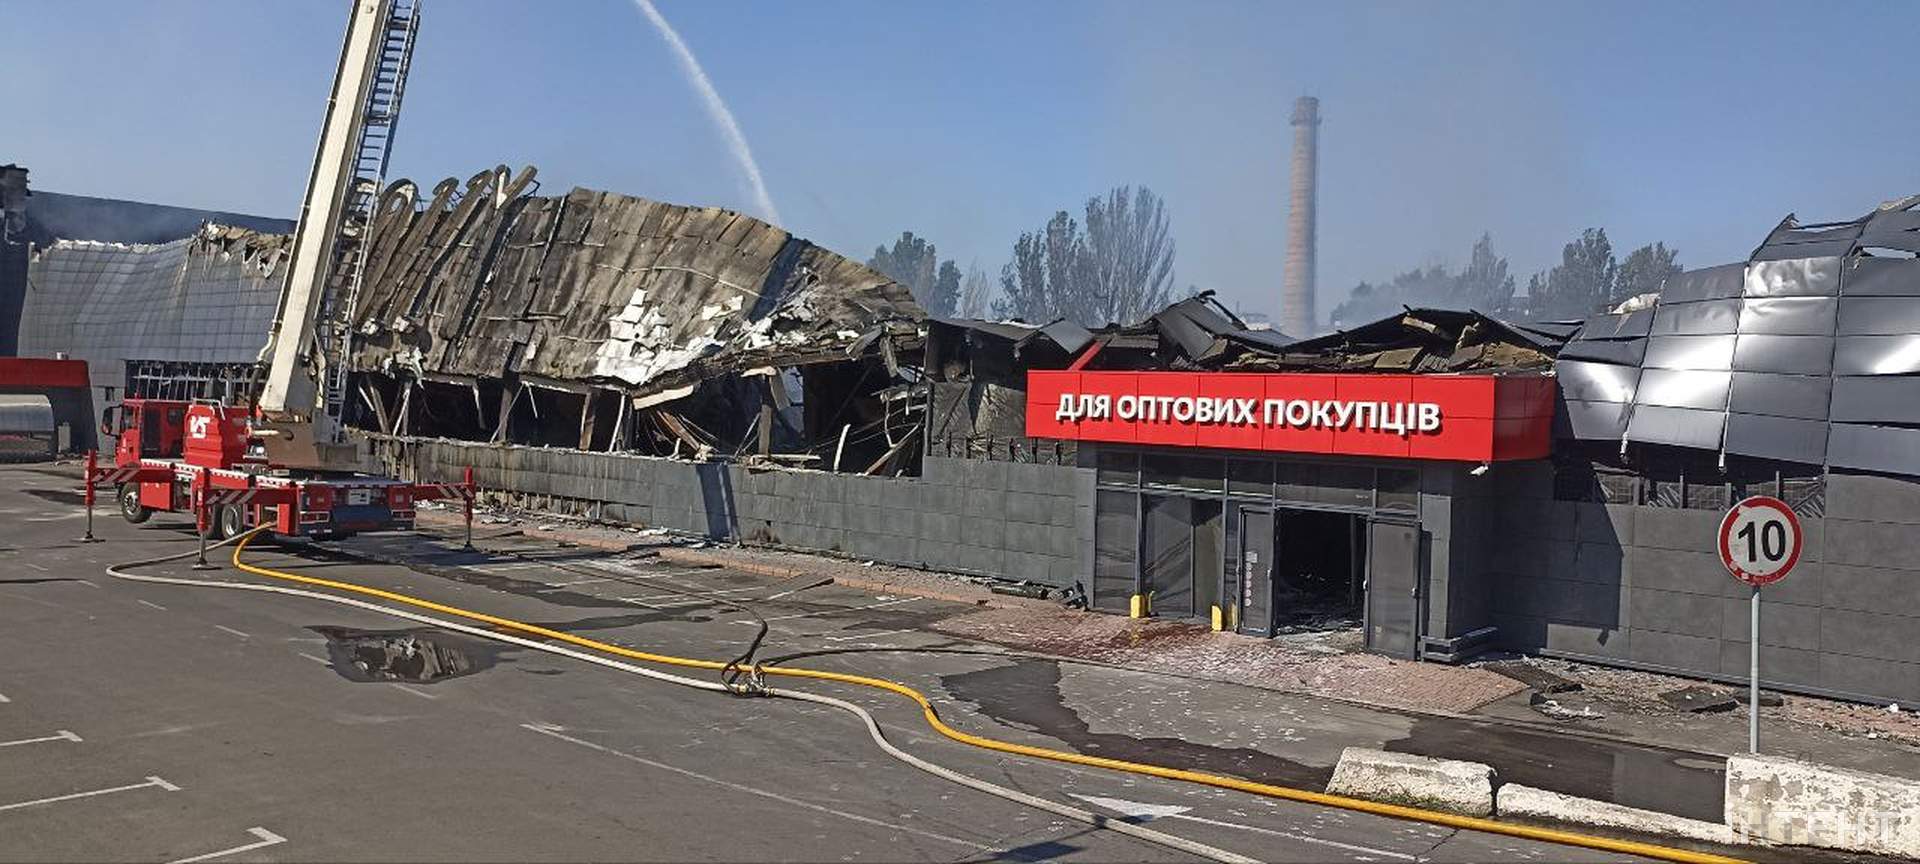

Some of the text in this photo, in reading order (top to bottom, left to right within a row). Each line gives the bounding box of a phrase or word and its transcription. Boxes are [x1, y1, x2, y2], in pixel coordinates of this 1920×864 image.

[1055, 393, 1442, 436] ДЛЯ ОПТОВИХ ПОКУПЦІВ
[1738, 520, 1786, 562] 10
